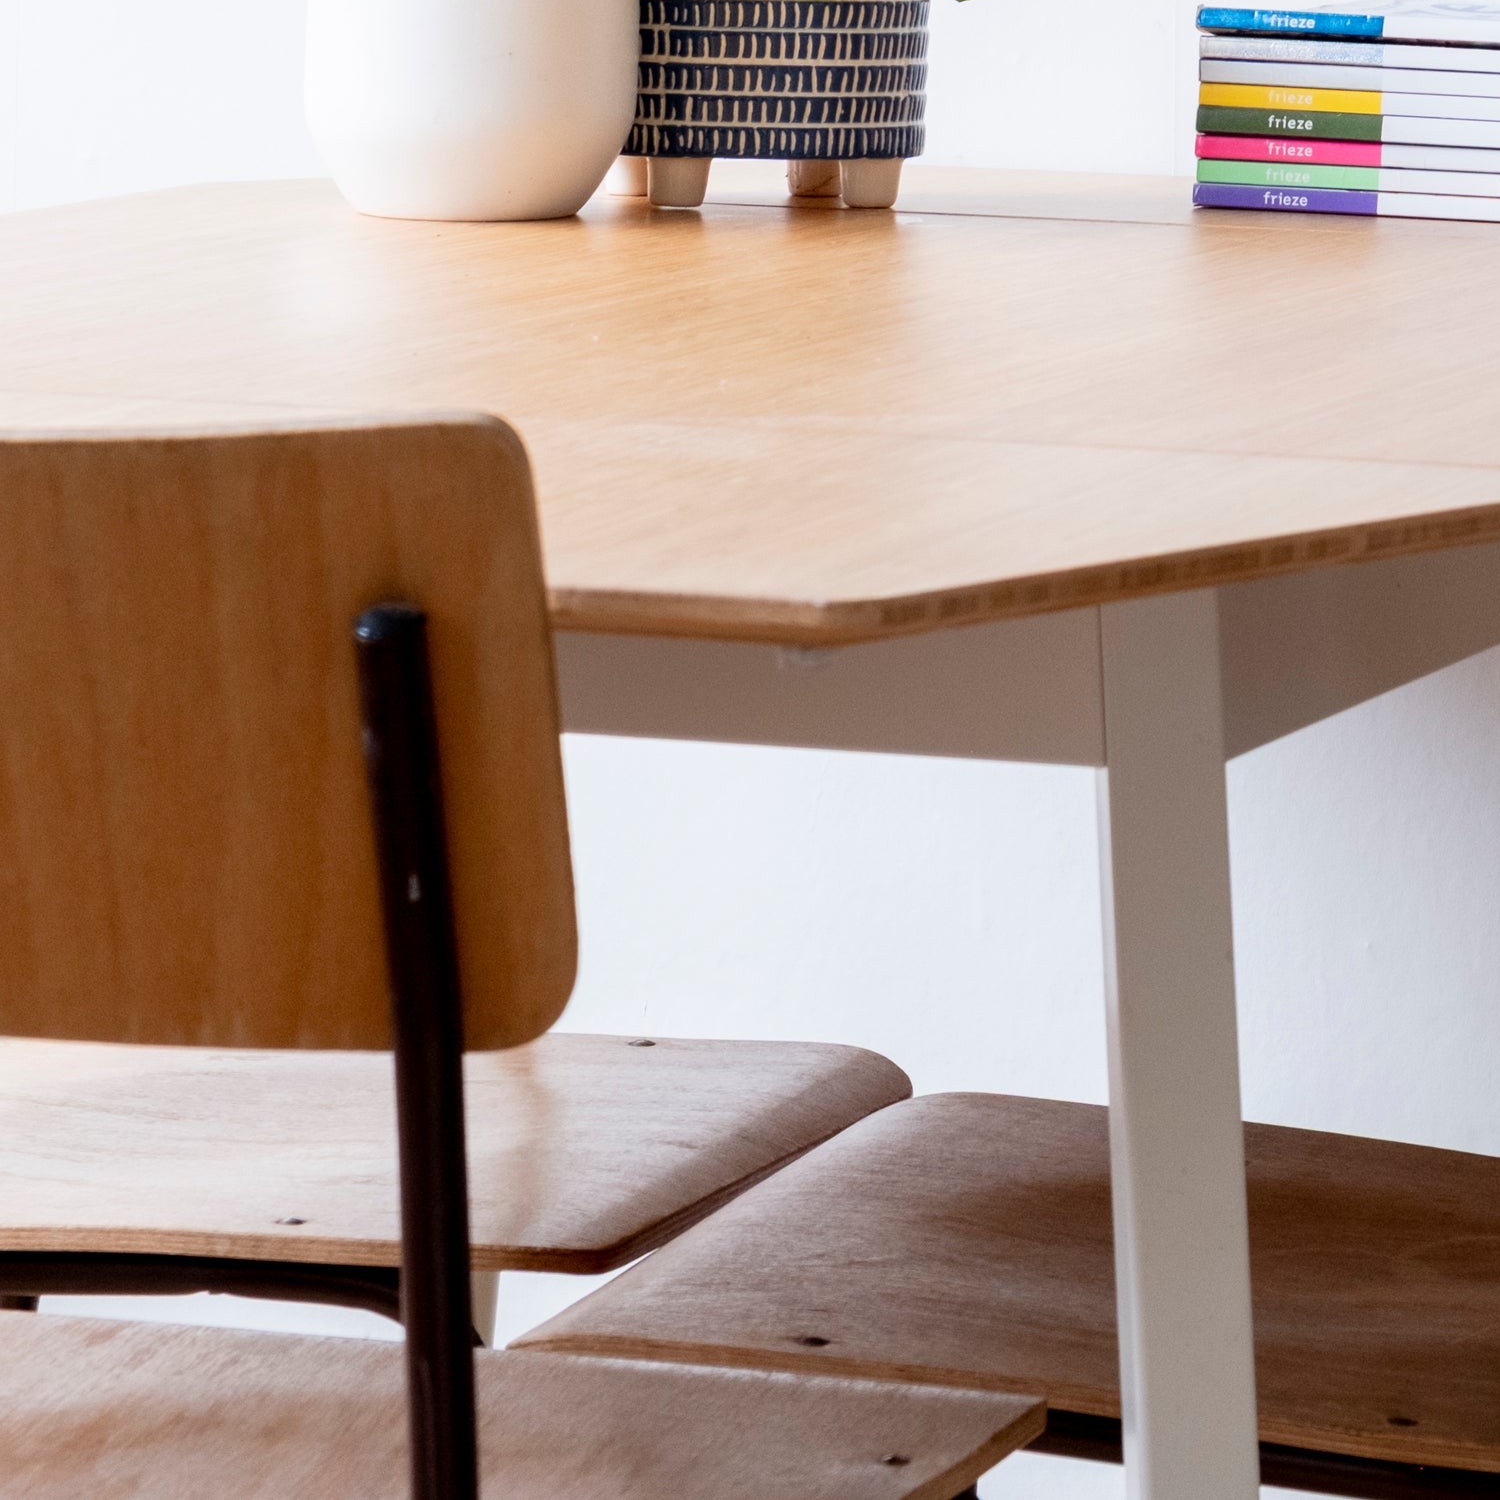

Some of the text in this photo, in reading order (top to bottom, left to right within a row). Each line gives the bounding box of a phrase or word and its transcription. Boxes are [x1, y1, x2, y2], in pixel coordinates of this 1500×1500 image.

[1270, 14, 1316, 29] frieze
[1268, 89, 1313, 105] frieze
[1268, 115, 1313, 130] frieze
[1268, 142, 1313, 157] frieze
[1265, 168, 1310, 184] frieze
[1263, 191, 1308, 207] frieze
